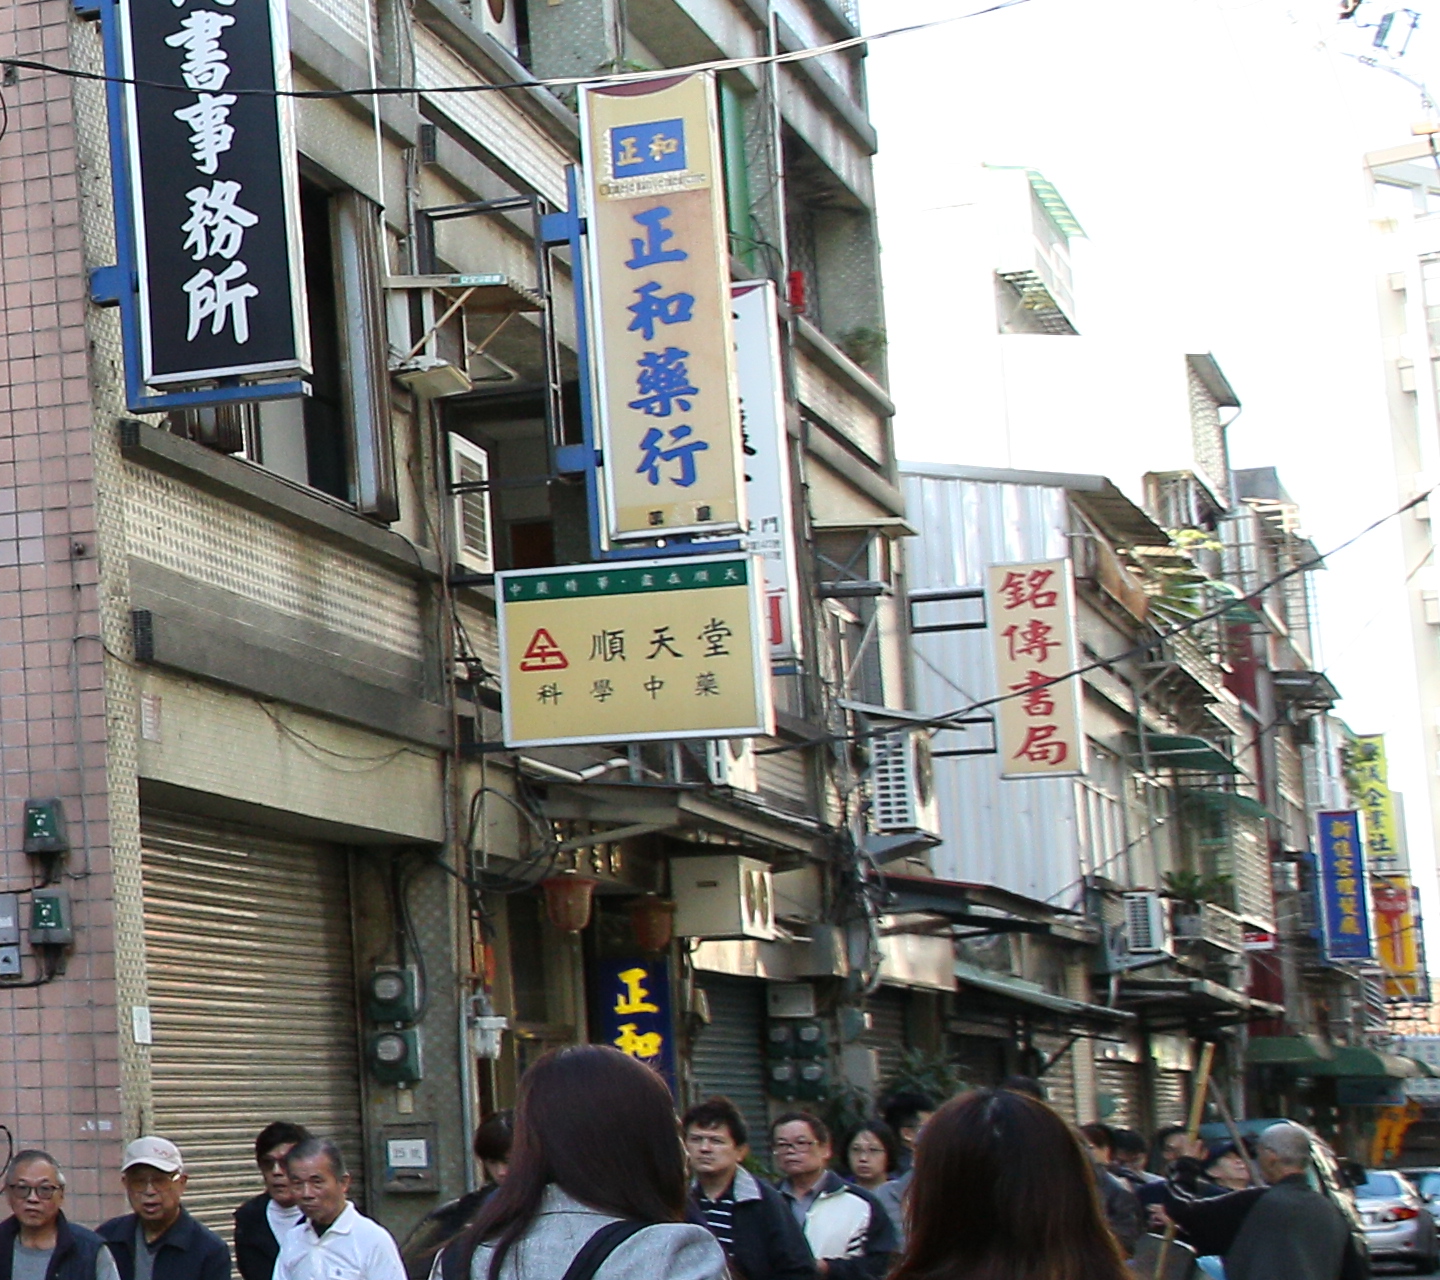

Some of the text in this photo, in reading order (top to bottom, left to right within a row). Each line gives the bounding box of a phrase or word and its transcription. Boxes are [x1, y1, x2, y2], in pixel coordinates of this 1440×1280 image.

[616, 132, 679, 166] 正和
[625, 206, 708, 488] 正和藥行
[588, 617, 733, 662] 順天堂
[998, 569, 1068, 765] 銘傳書局
[537, 671, 721, 706] 科學中藥
[613, 967, 662, 1058] 正和
